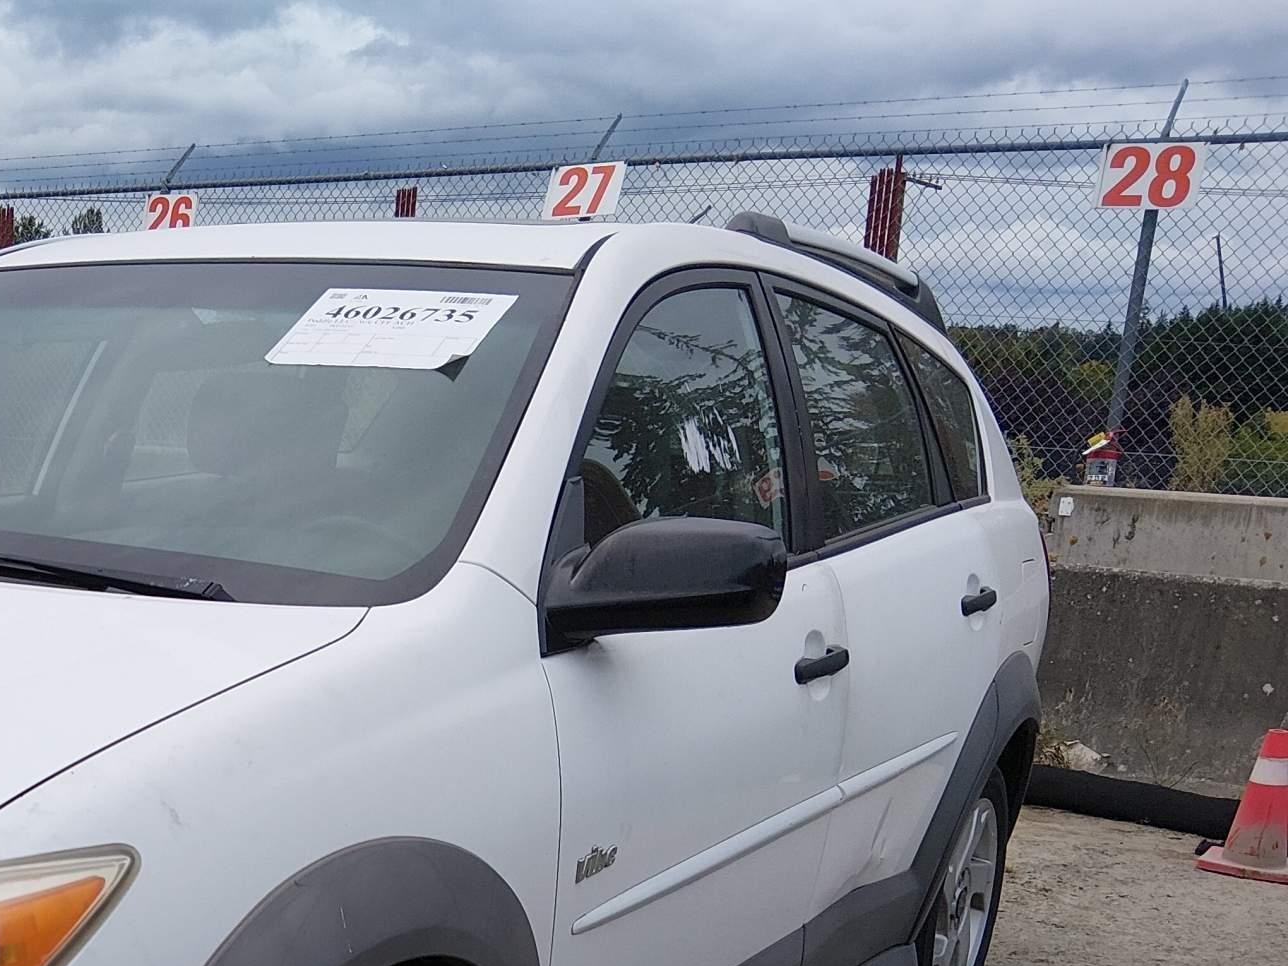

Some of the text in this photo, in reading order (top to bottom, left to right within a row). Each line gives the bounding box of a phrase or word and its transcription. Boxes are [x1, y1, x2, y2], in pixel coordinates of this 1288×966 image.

[551, 165, 616, 217] 27
[1101, 145, 1196, 208] 28
[148, 196, 193, 231] 26
[325, 304, 480, 323] 46026735
